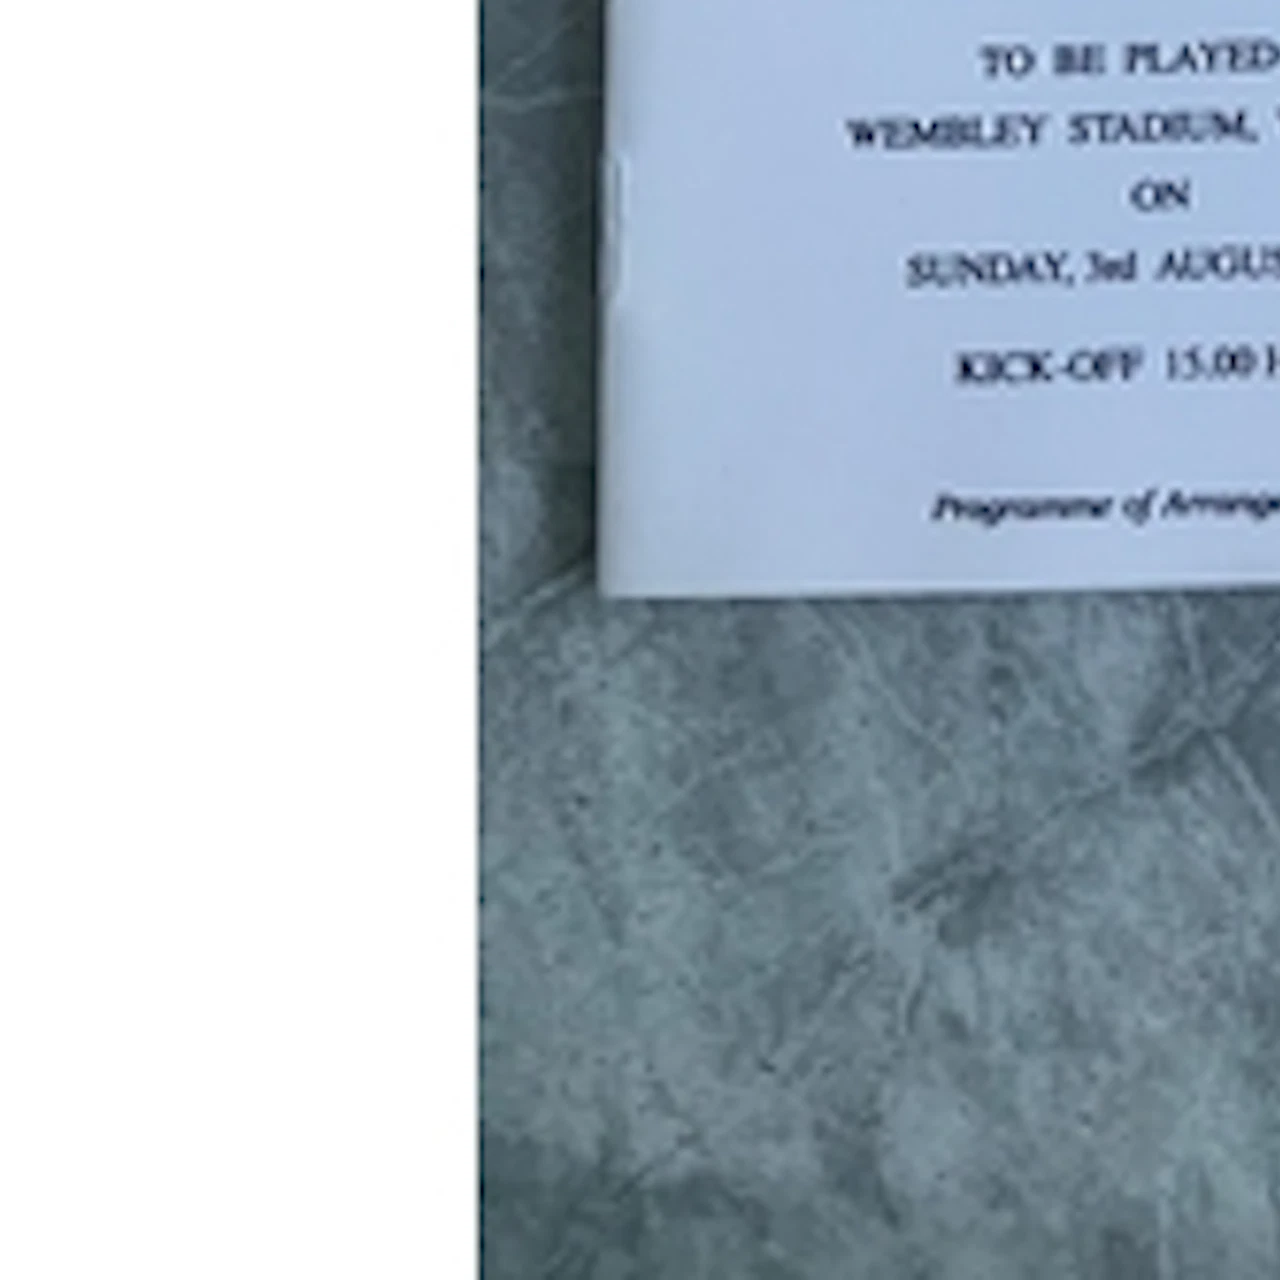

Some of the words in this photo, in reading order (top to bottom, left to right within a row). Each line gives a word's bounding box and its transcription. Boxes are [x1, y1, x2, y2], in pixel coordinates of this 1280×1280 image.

[980, 44, 1037, 79] TO
[1053, 44, 1105, 76] BE
[846, 113, 1046, 150] WEMBLEY
[1068, 109, 1259, 144] STADIUM,
[1129, 180, 1190, 212] ON
[907, 251, 1075, 288] SUNDAY,
[1085, 249, 1138, 282] 3rd
[956, 349, 1142, 385] KICK-OFF
[1167, 345, 1258, 380] 15.00
[930, 493, 1114, 528] Programme
[1121, 488, 1158, 527] of
